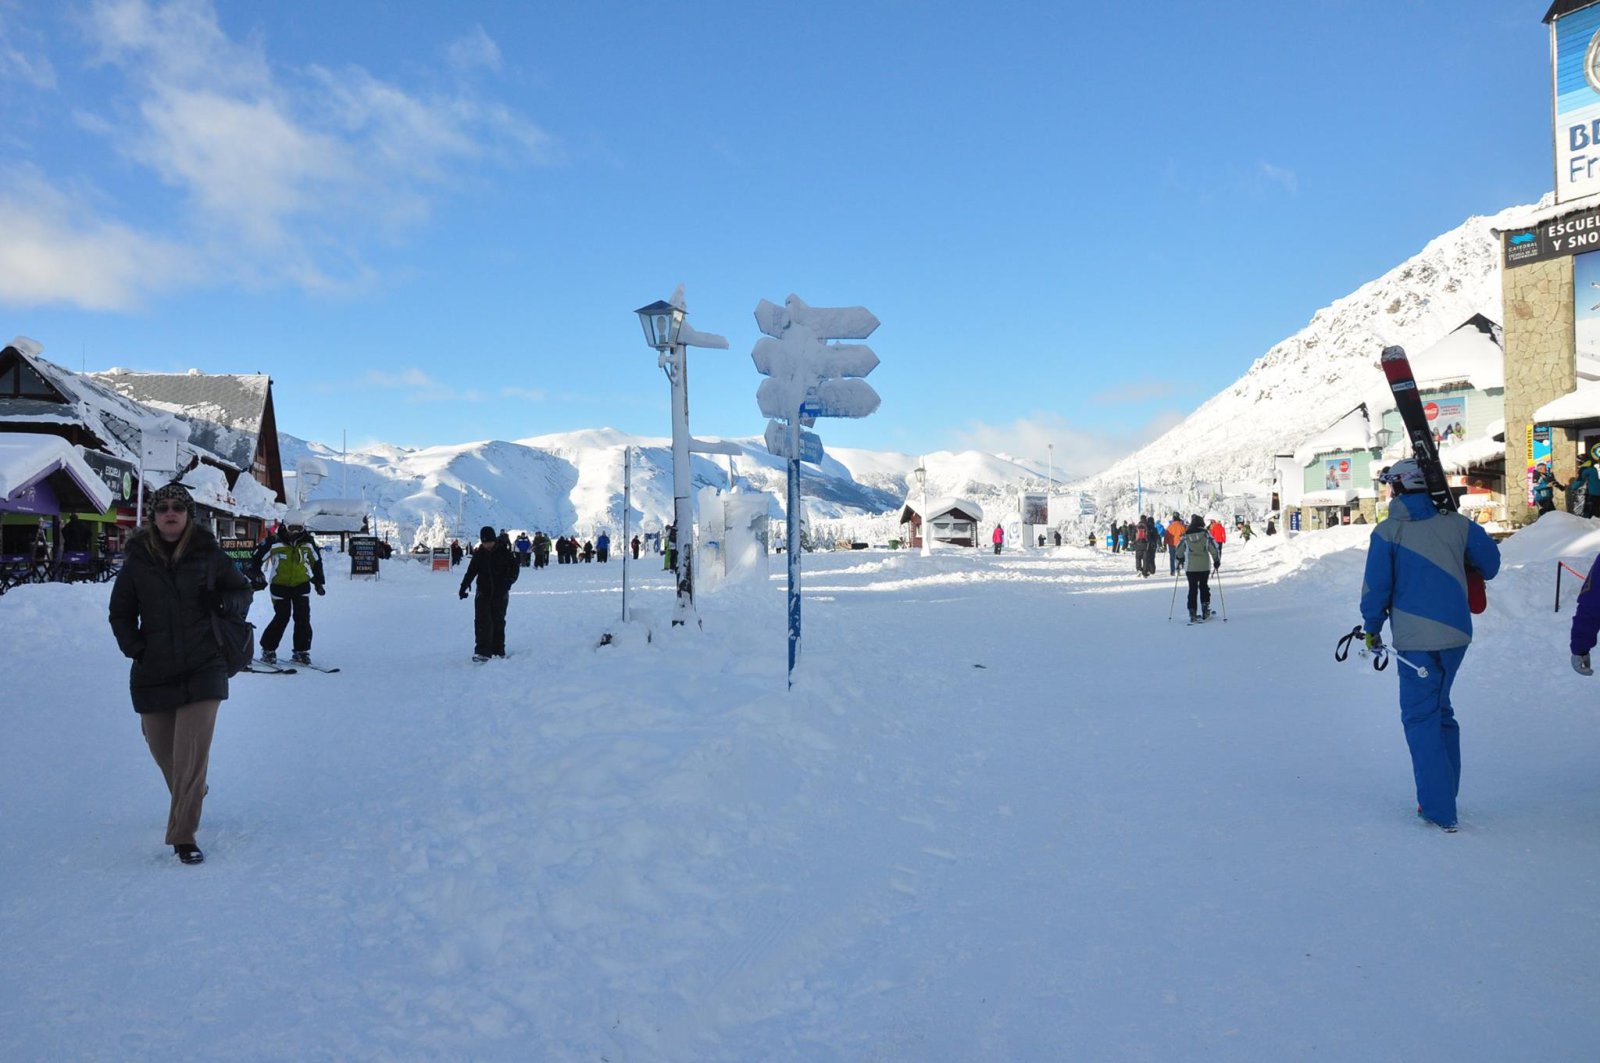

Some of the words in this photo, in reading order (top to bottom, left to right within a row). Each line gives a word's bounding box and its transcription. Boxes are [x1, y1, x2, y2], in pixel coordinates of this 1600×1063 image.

[1570, 154, 1600, 183] Fr
[1552, 239, 1562, 251] Y
[1568, 231, 1600, 248] SNO
